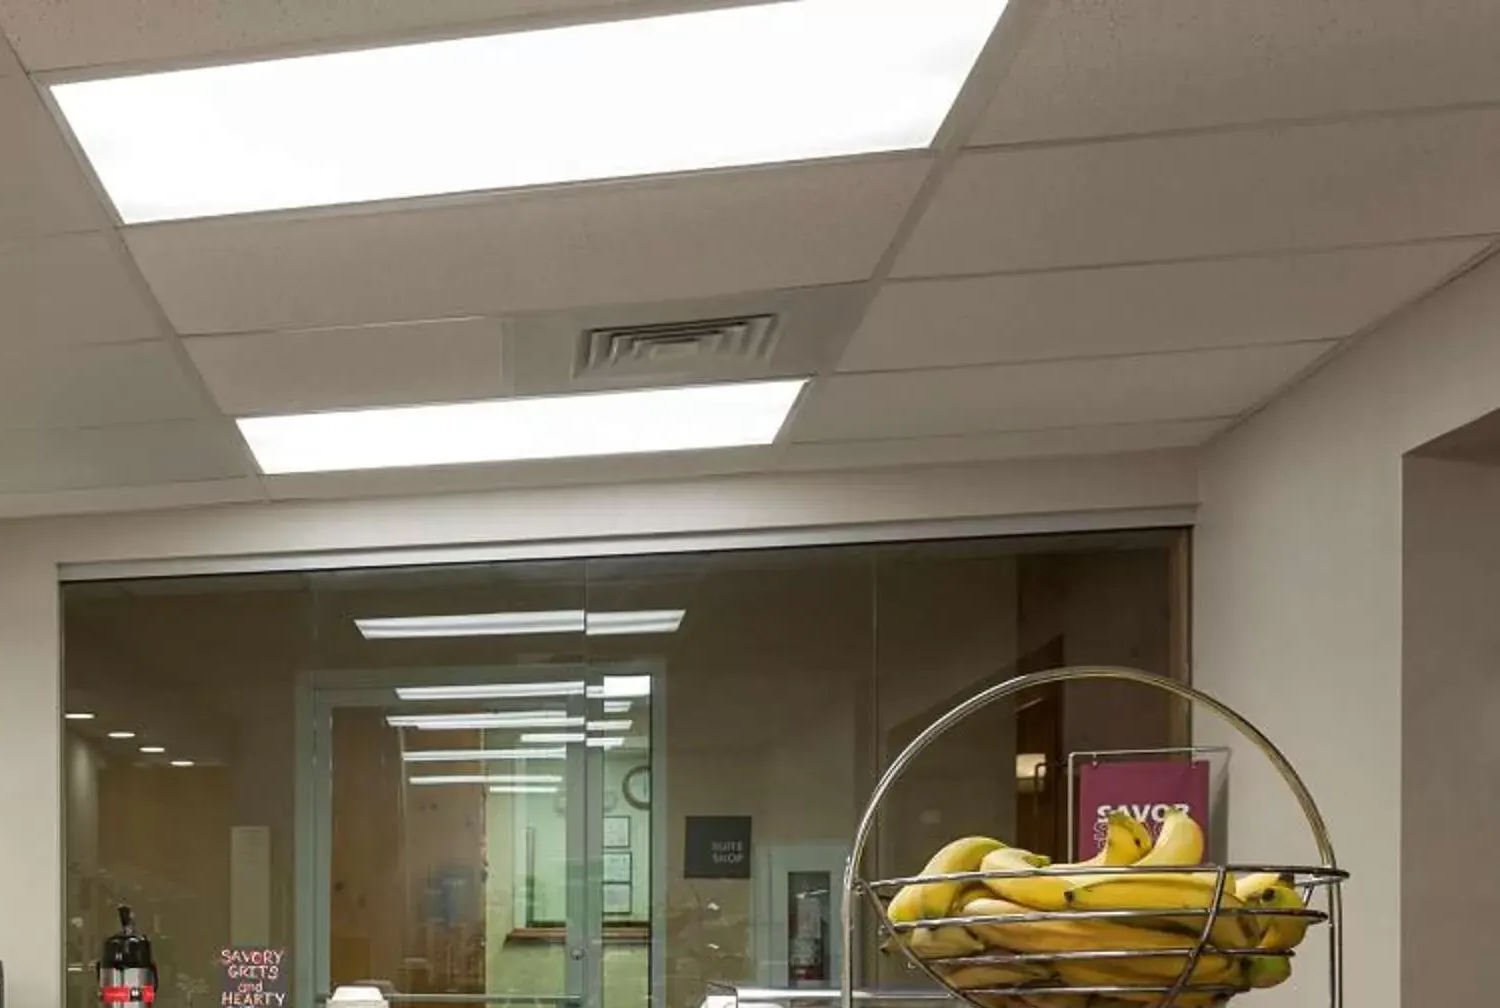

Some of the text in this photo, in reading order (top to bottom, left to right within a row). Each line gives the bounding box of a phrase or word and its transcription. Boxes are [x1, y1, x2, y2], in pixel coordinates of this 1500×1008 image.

[221, 949, 284, 964] SAVORY
[228, 965, 279, 979] GRITS
[238, 980, 263, 993] and
[221, 992, 286, 1007] HEARTY
